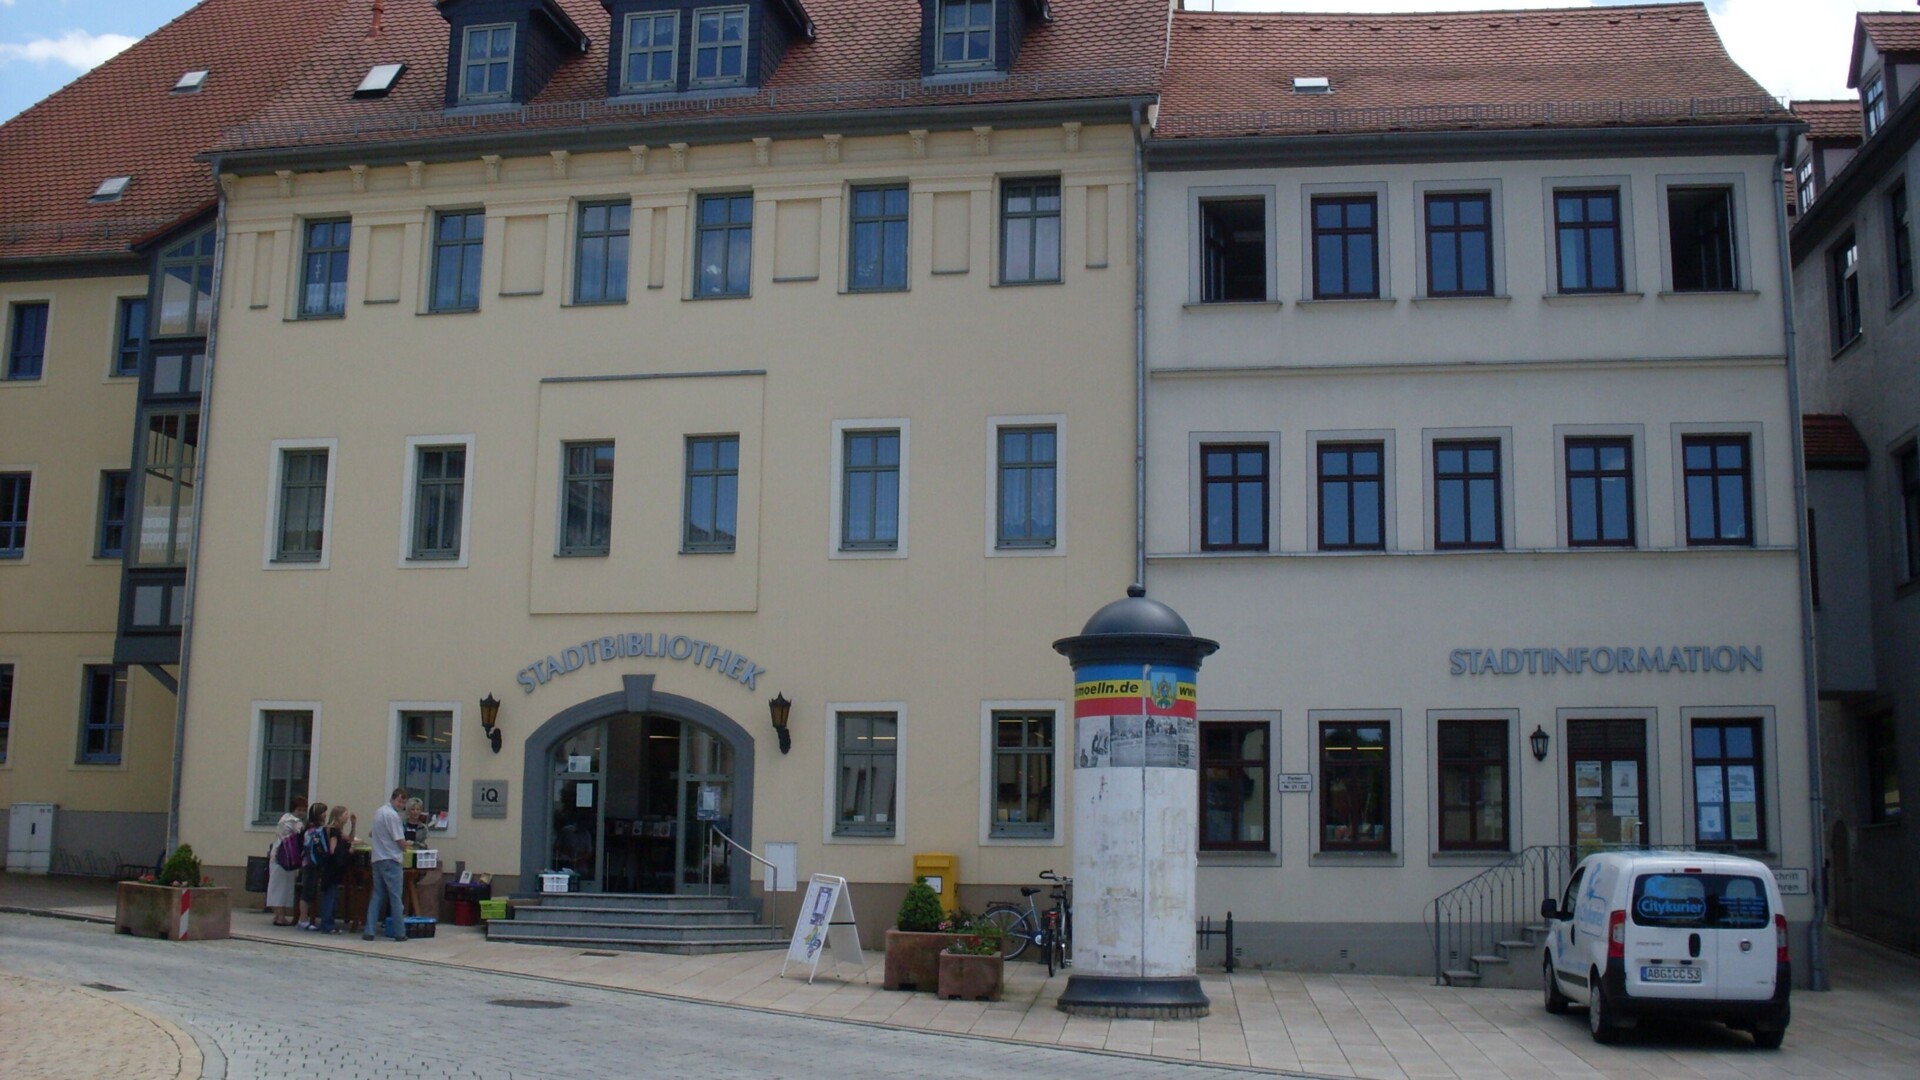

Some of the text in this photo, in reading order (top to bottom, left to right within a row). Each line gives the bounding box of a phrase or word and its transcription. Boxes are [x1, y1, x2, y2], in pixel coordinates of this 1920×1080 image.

[516, 632, 766, 694] STADTBIBLIOTHEK
[1449, 645, 1763, 676] STADTINFORMATION
[481, 787, 498, 803] iQ
[1774, 872, 1799, 881] chritt
[1777, 883, 1799, 892] hren
[1641, 899, 1703, 915] Citykurier
[1647, 967, 1700, 980] ABG CC 53
